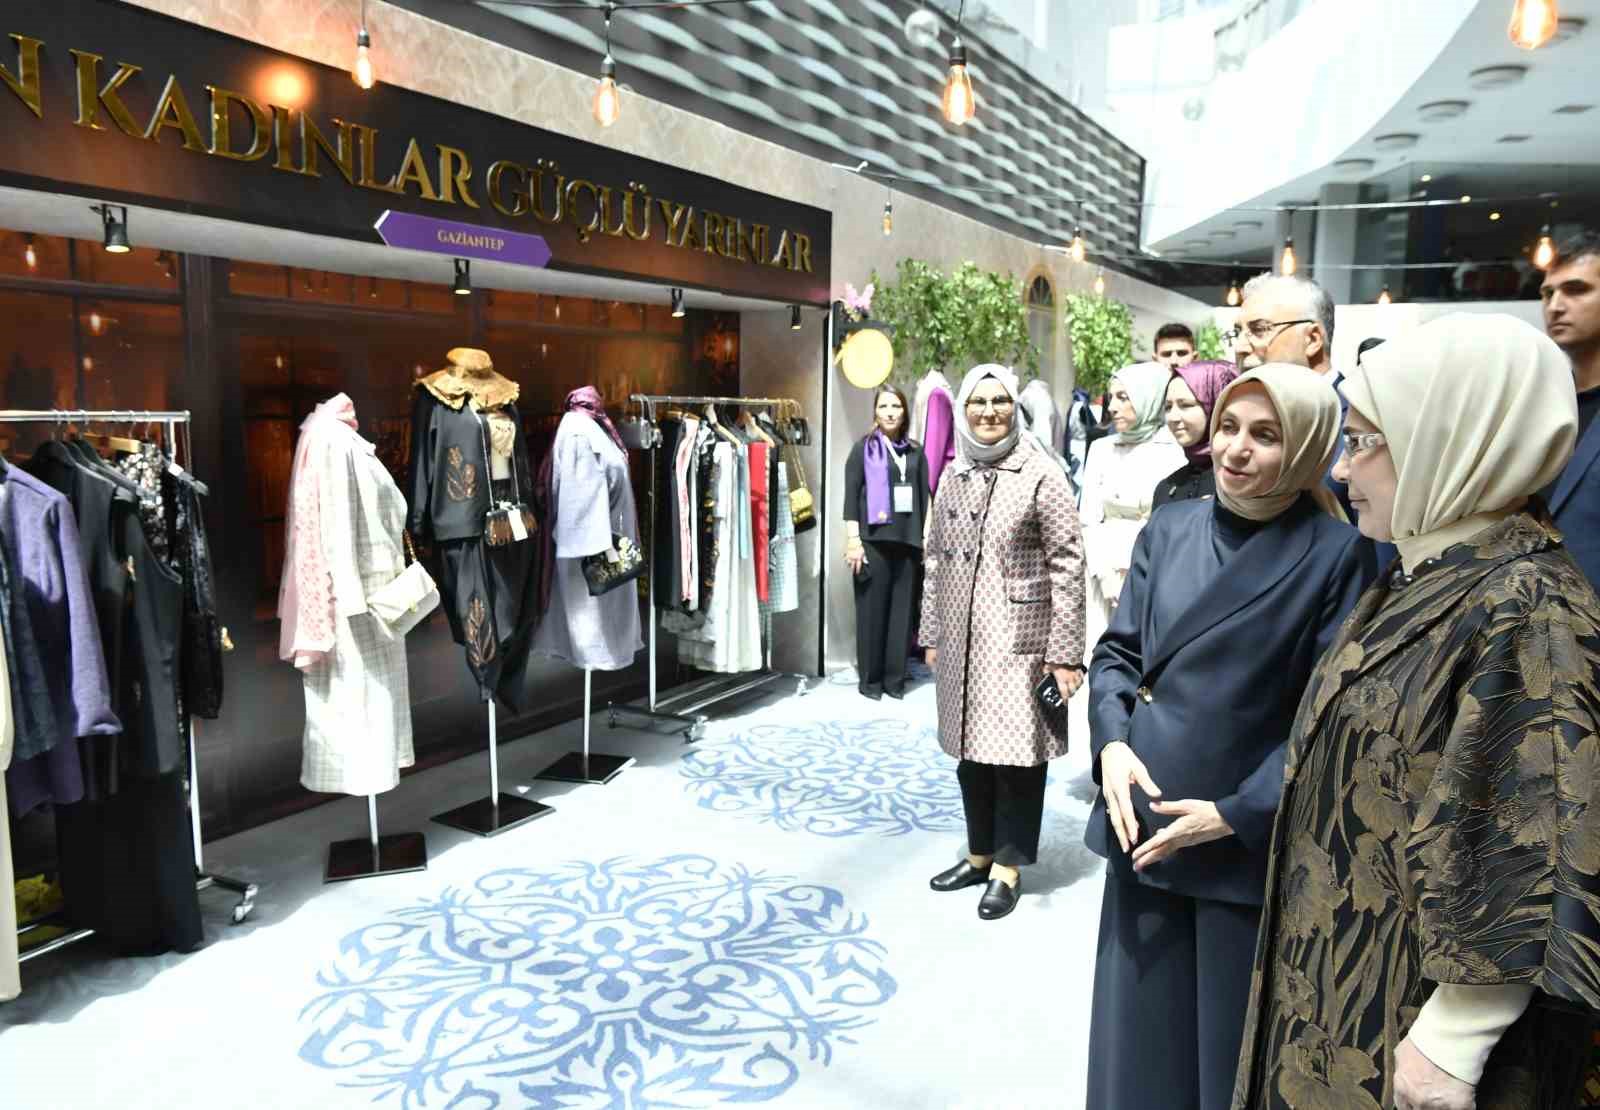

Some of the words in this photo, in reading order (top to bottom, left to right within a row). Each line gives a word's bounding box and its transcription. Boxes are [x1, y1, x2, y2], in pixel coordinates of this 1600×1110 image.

[68, 48, 480, 209] KADINLAR
[486, 158, 650, 243] GÜÇLÜ
[660, 199, 813, 272] YARINLAR
[437, 230, 504, 251] GAZİANTEP
